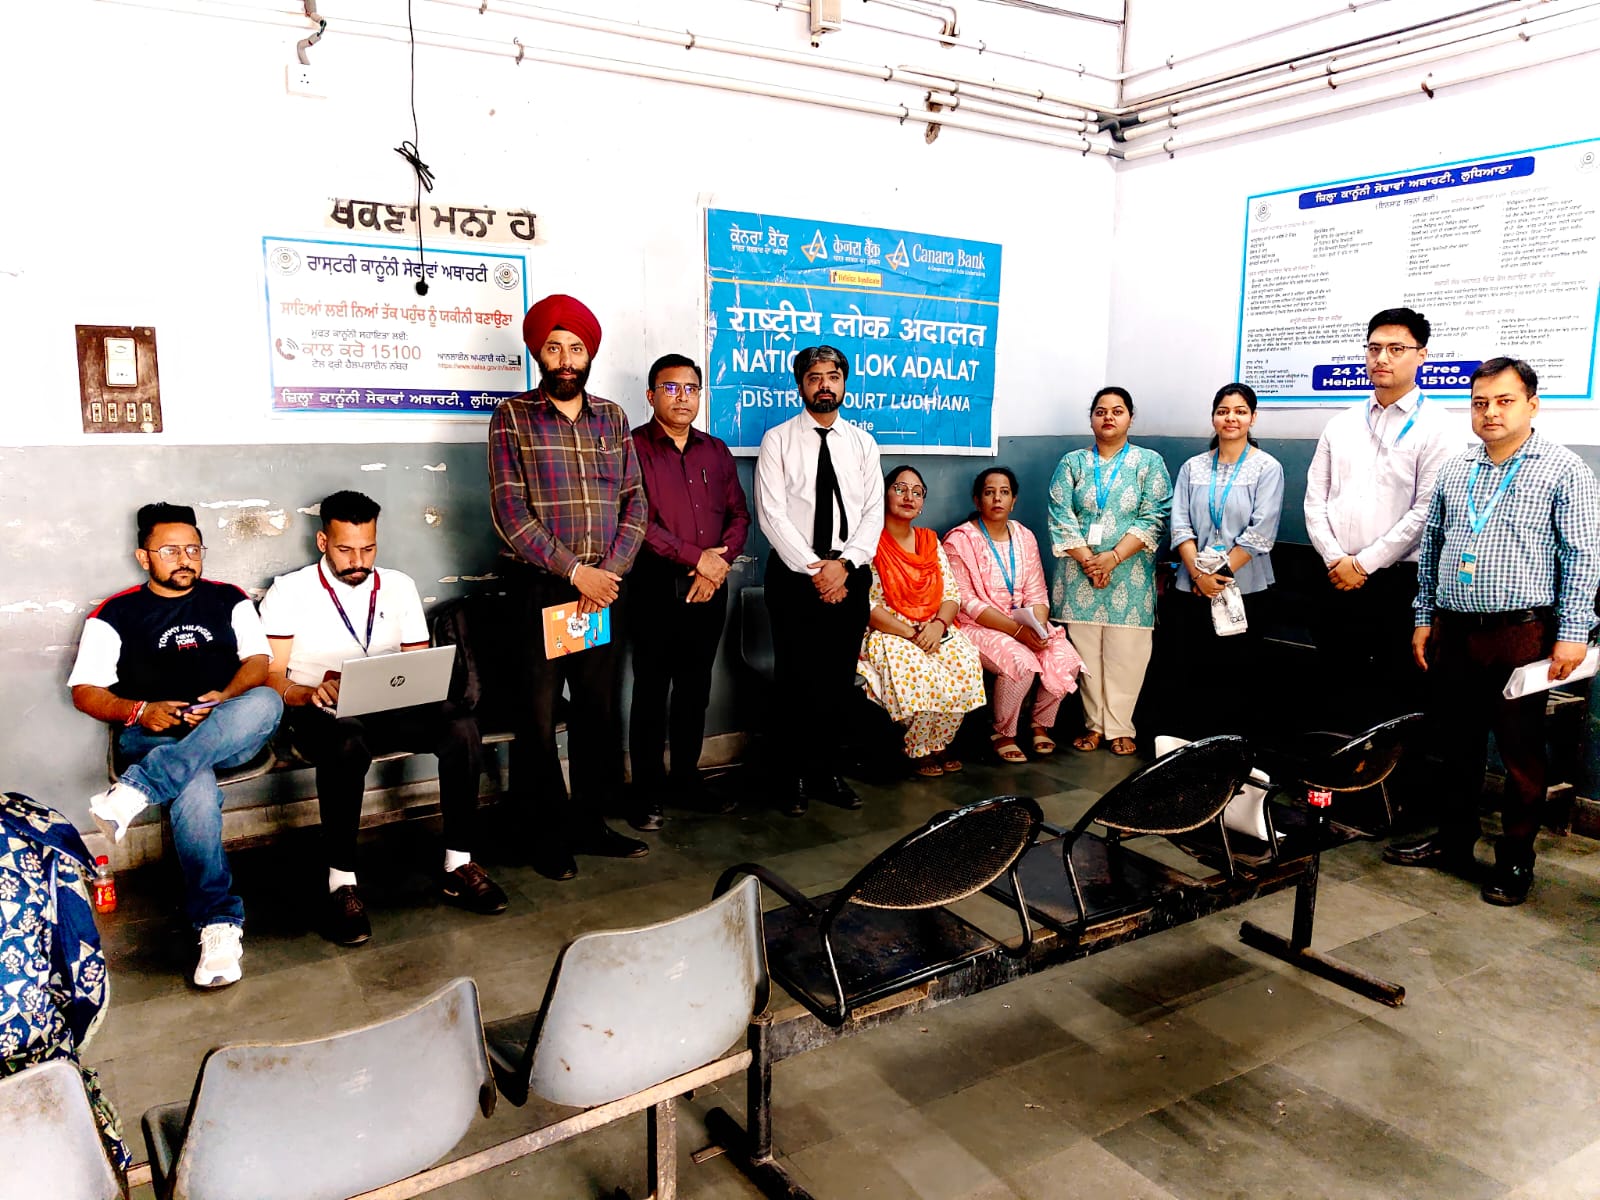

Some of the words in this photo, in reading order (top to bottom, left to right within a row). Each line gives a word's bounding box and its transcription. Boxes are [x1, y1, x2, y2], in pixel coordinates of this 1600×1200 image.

[1461, 164, 1513, 183] ਲੁਧਿਆਣਾ
[729, 223, 763, 246] ਕੇਨਰਾ
[767, 226, 790, 249] ਬੈਂਕ
[833, 234, 862, 256] केनरा
[912, 244, 954, 266] Canara
[957, 249, 986, 270] Bank
[306, 254, 357, 276] ਰਾਸ਼ਟਰੀ
[360, 255, 399, 283] ਕਾਨੂੰਨੀ
[402, 258, 438, 279] ਸੇਵਵਾਂ
[441, 262, 488, 283] ਅਥਾਰਟੀ
[324, 300, 348, 318] ਲਈ
[381, 303, 399, 321] ਤੱਕ
[428, 305, 437, 328] ਨੂੰ
[439, 306, 473, 324] ਯਕੀਨੀ
[474, 309, 513, 329] ਬਣਾਉਣਾ
[726, 300, 822, 342] राष्ट्रीय
[831, 304, 891, 340] लोक
[899, 318, 988, 348] अदालत
[301, 342, 334, 357] ਕਾਲ
[371, 343, 422, 361] 15100
[732, 348, 800, 374] NATI
[855, 353, 898, 378] LOK
[901, 356, 980, 382] ADALAT
[1332, 367, 1351, 376] 24
[1355, 366, 1367, 376] X
[1422, 364, 1461, 374] Free
[1323, 377, 1374, 388] Helplin
[1420, 376, 1471, 385] 15100
[319, 389, 360, 409] ਕਾਨੂੰਨੀ
[365, 390, 405, 405] ਸੇਵਾਵਾਂ
[470, 392, 510, 409] ਲੁਧਿਆ
[742, 389, 804, 408] DISTR
[842, 392, 887, 410] OURT
[890, 393, 971, 412] LUDHIANA
[158, 625, 180, 649] TOMMY
[175, 632, 194, 641] NEW
[175, 637, 197, 647] YORK
